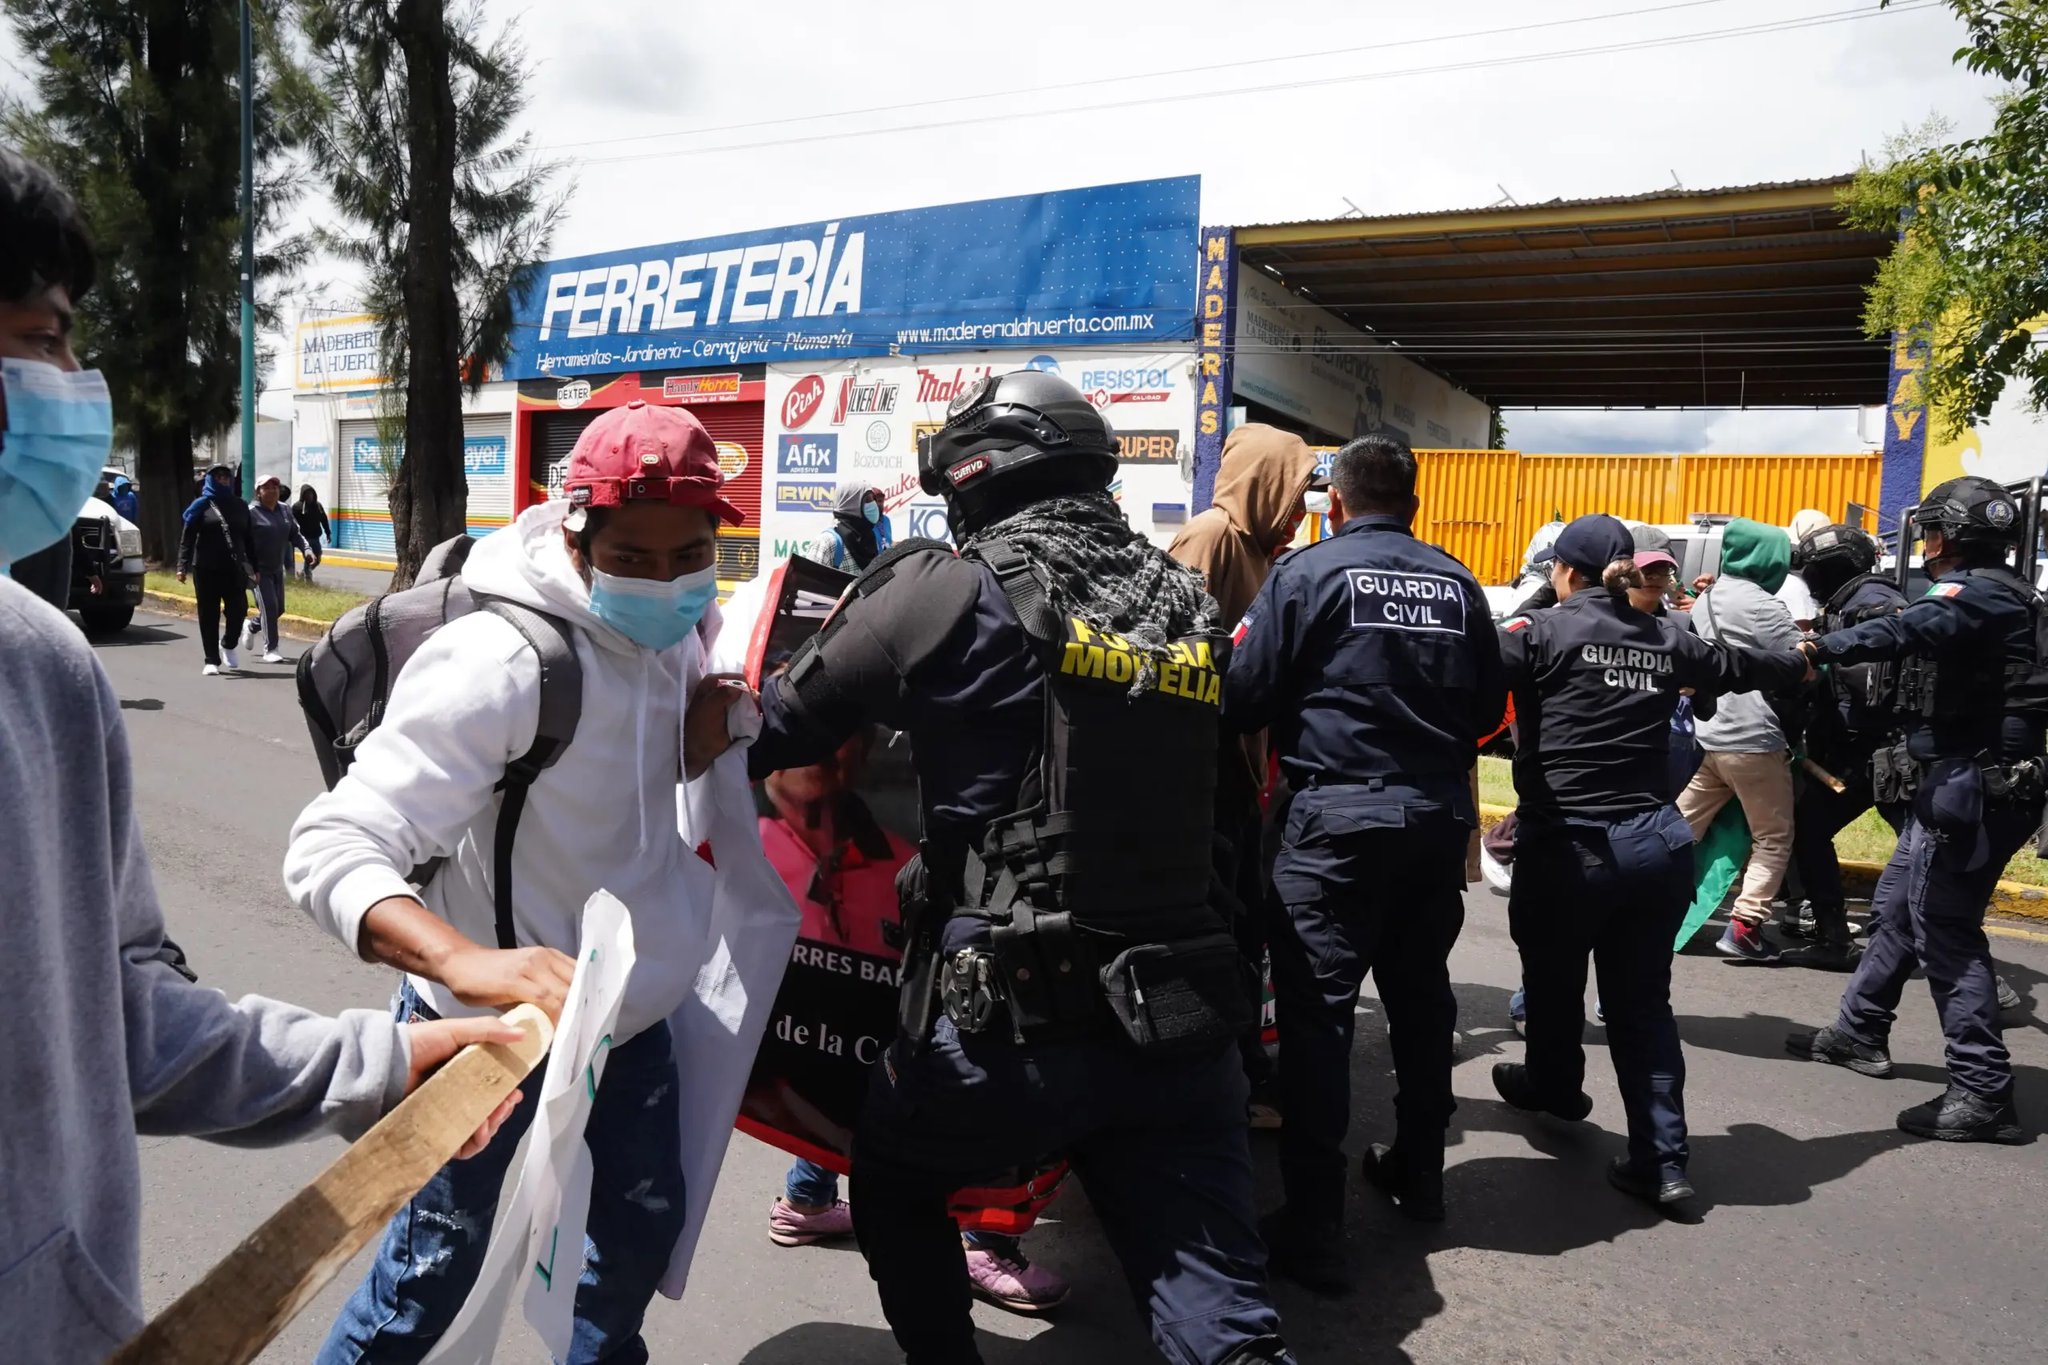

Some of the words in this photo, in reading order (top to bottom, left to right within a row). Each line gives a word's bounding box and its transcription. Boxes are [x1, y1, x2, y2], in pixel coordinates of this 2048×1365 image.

[539, 222, 865, 341] FERRETERÍA
[1200, 236, 1226, 435] MADERAS
[303, 357, 323, 375] LA
[328, 352, 378, 374] HUERT
[1081, 368, 1176, 390] RESISTOL
[558, 387, 589, 400] DEXTER
[785, 380, 823, 427] Rish
[299, 448, 328, 468] Sayer
[464, 445, 500, 471] ayer
[785, 443, 831, 466] Afix
[1115, 436, 1174, 459] RUPER
[953, 460, 983, 481] CUERVO
[774, 539, 811, 557] MAS
[1356, 575, 1458, 602] GUARDIA
[1382, 602, 1442, 624] CIVIL
[1581, 644, 1674, 674] GUARDIA
[1604, 668, 1658, 692] CIVIL
[792, 944, 852, 975] RRES
[776, 1014, 809, 1045] de
[817, 1023, 843, 1056] la
